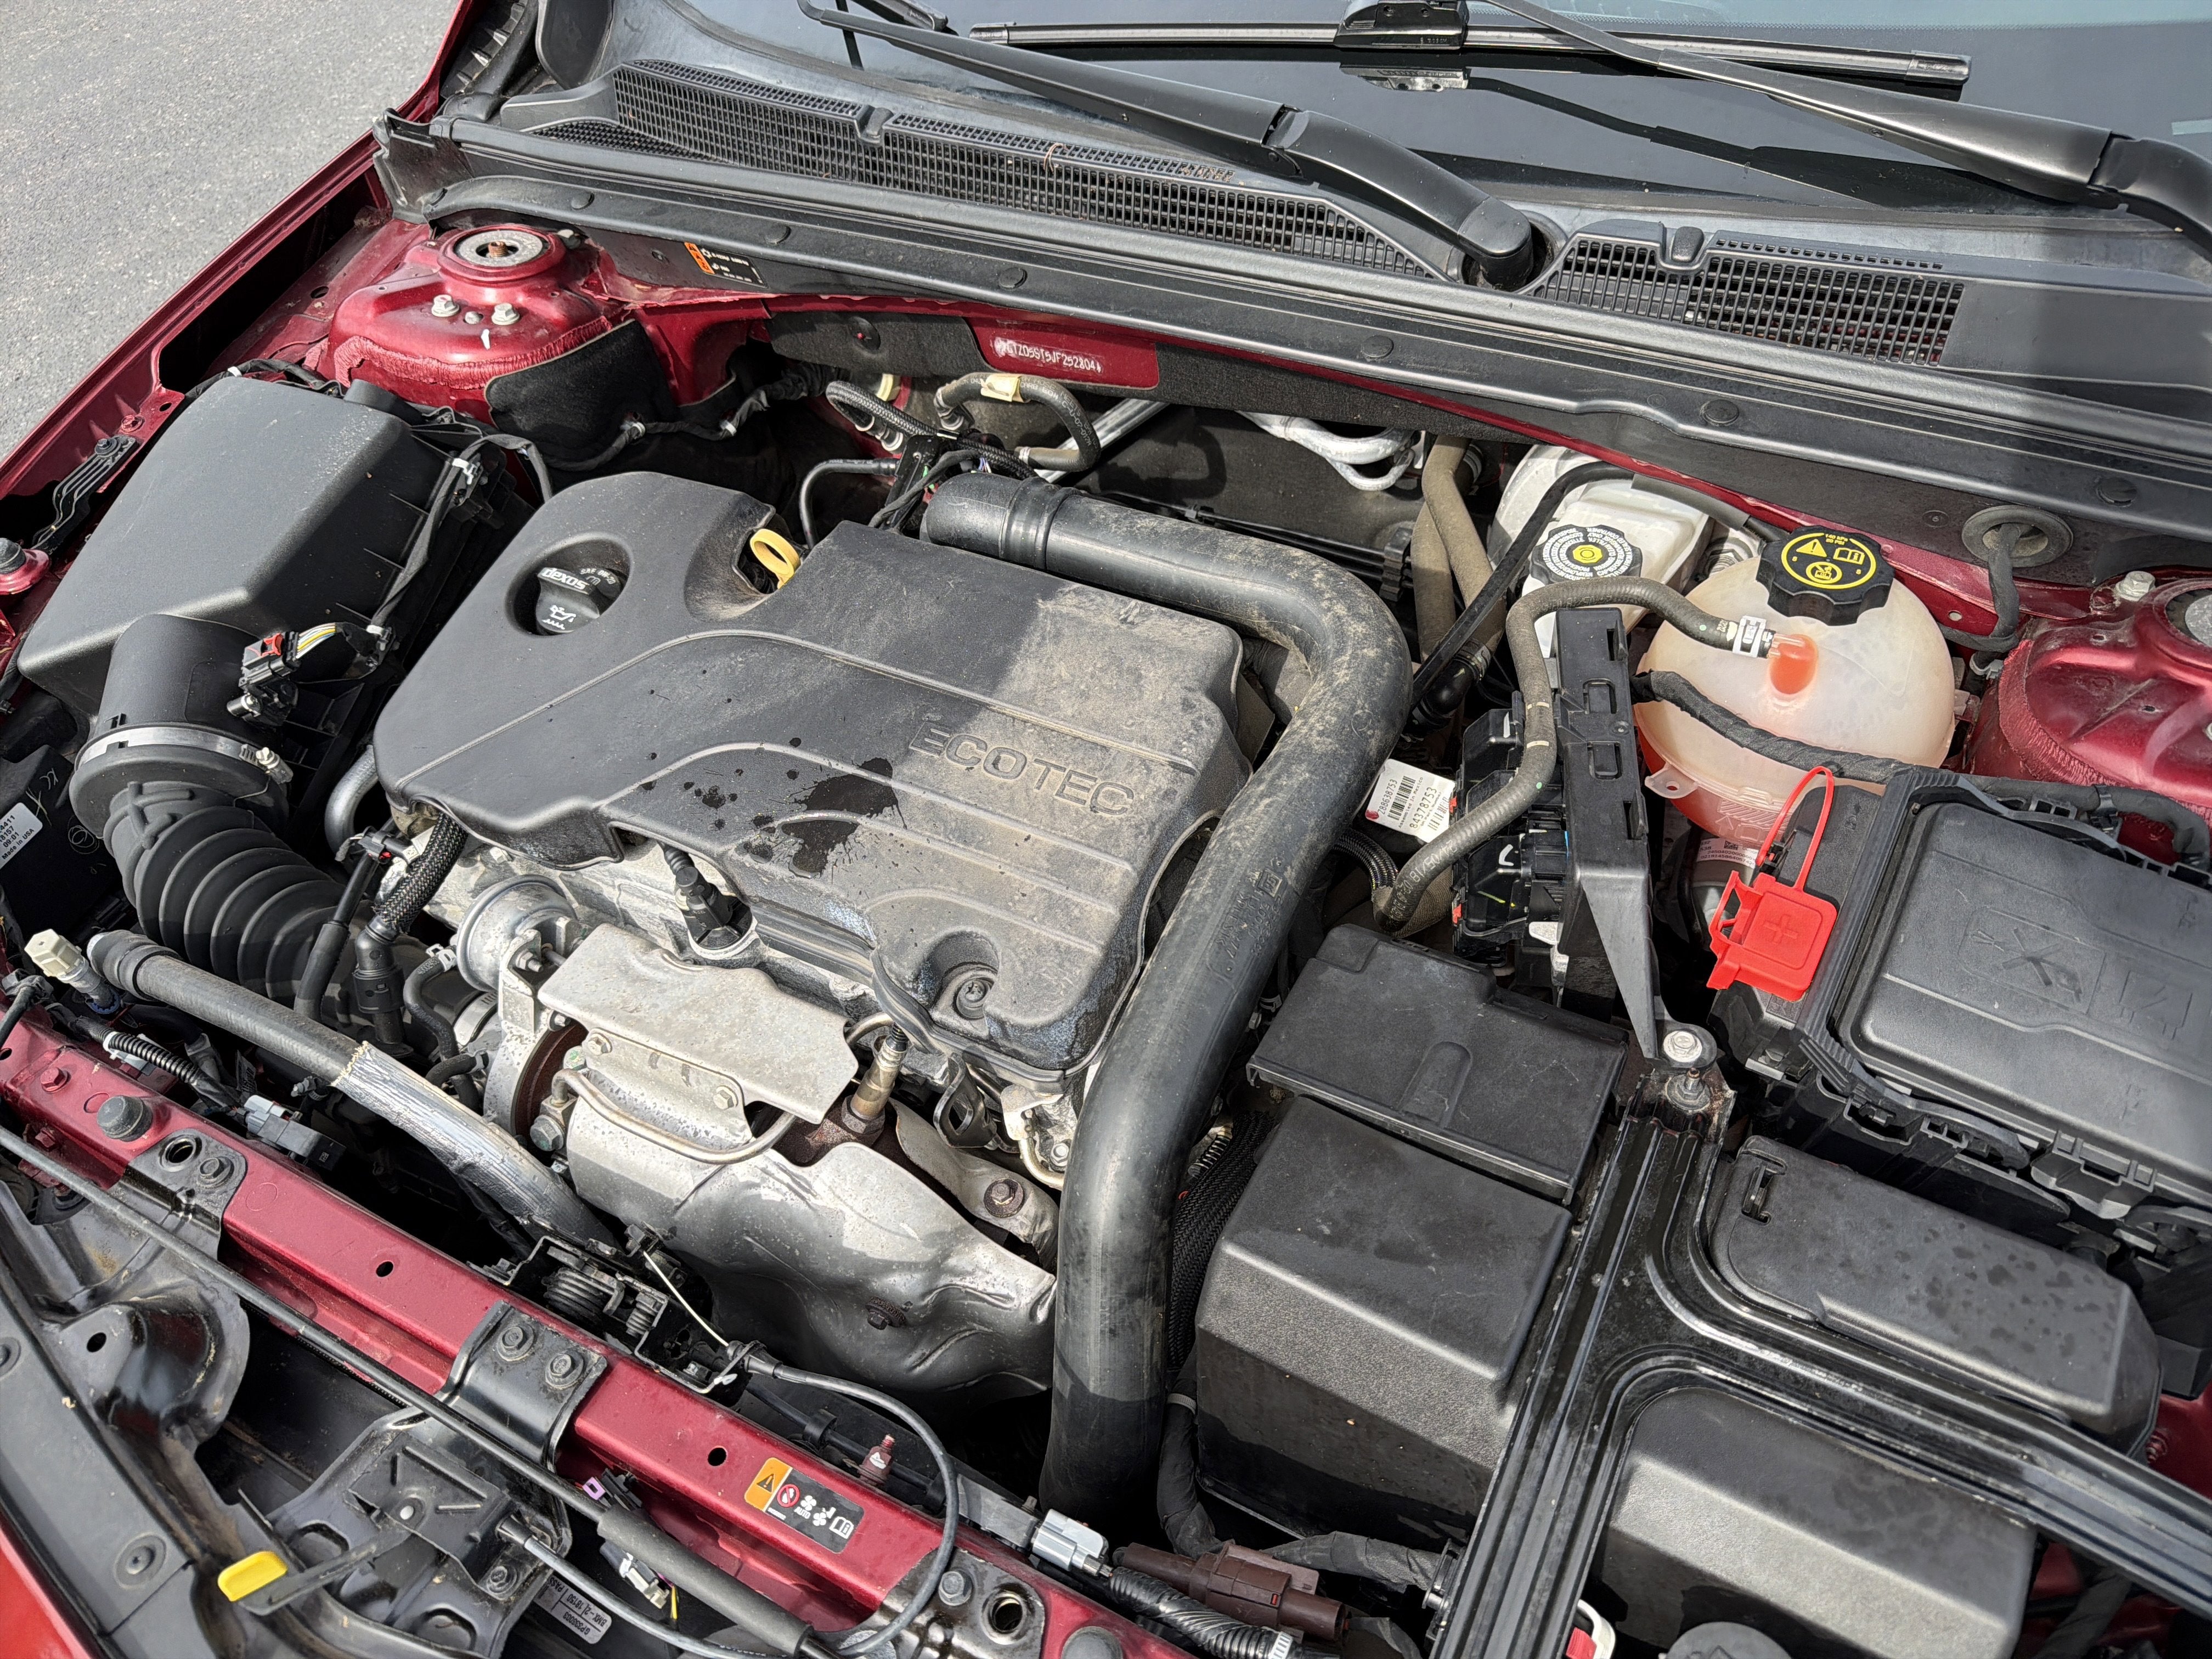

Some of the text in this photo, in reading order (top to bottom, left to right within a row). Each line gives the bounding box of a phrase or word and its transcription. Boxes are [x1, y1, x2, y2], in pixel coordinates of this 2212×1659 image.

[541, 568, 590, 590] dexos
[909, 722, 1135, 816] ECOTEC
[1409, 787, 1437, 828] 84378753
[2, 845, 17, 860] Made
[22, 828, 35, 839] USA
[3, 831, 19, 848] 09:01
[793, 1506, 811, 1519] AUTO
[549, 1577, 565, 1593] PASS
[566, 1593, 584, 1610] 18150
